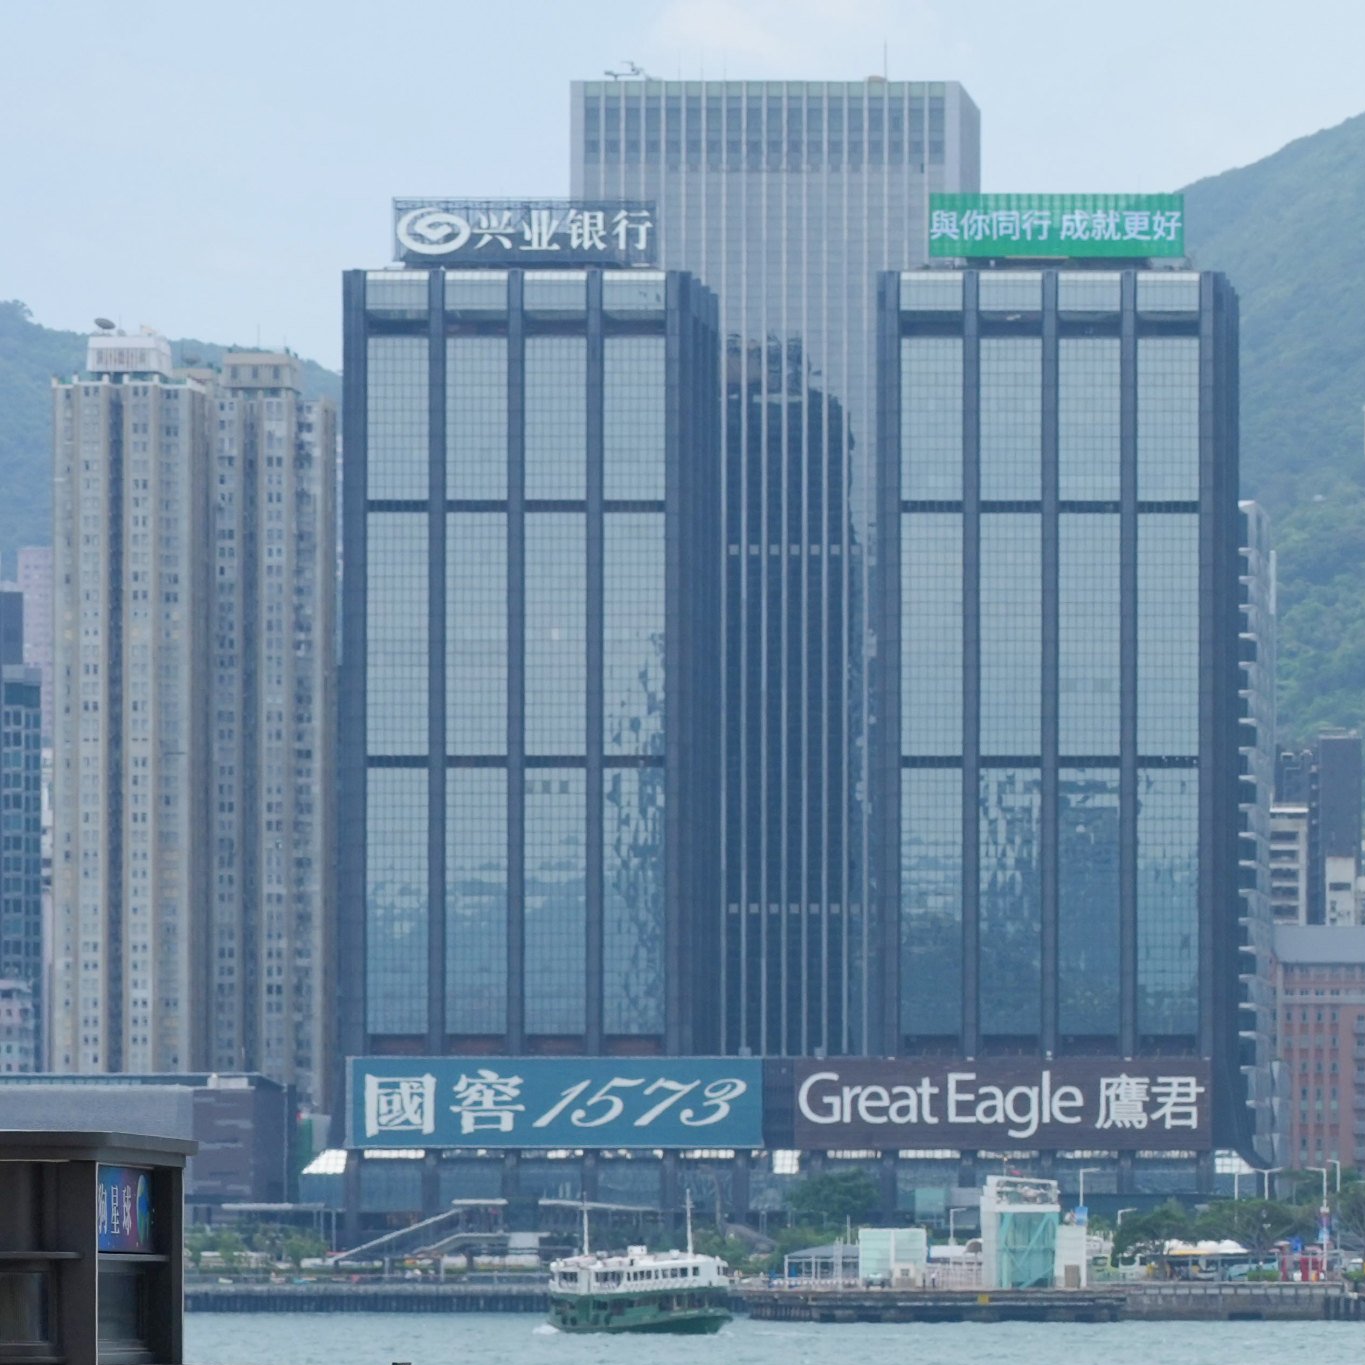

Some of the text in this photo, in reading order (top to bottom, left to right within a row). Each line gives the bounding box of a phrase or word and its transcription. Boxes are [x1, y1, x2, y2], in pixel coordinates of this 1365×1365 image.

[472, 208, 654, 251] 兴业银行
[930, 209, 1182, 241] 與你同行 成就更好
[365, 1069, 748, 1138] 國窖 1573
[798, 1070, 1205, 1139] Great Eagle 鷹君
